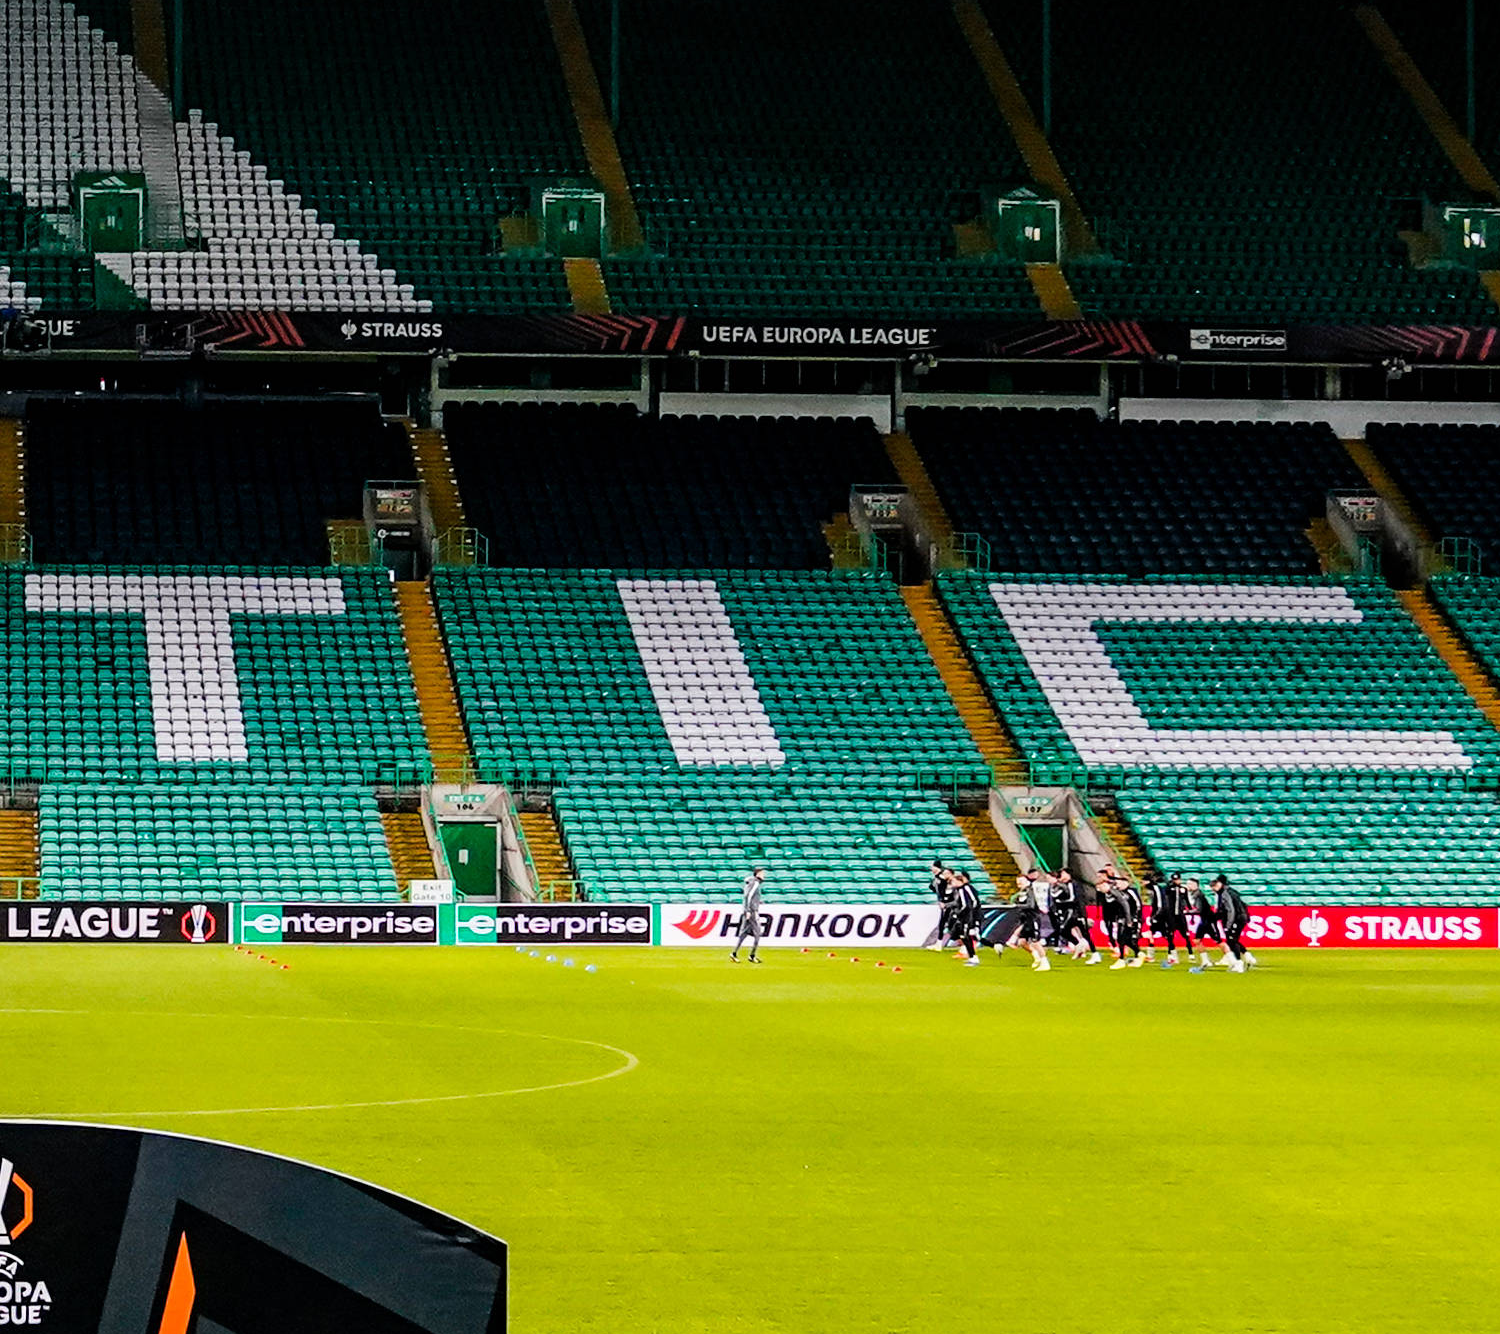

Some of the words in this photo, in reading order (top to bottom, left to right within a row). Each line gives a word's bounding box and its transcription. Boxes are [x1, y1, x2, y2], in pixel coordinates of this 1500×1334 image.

[361, 322, 443, 338] STRAUSS
[703, 326, 757, 343] UEFA
[763, 326, 845, 344] EUROPA
[1192, 331, 1285, 348] enterprise
[243, 911, 435, 941] enterprise
[458, 911, 650, 941] enterprise
[1345, 915, 1482, 941] STRAUSS
